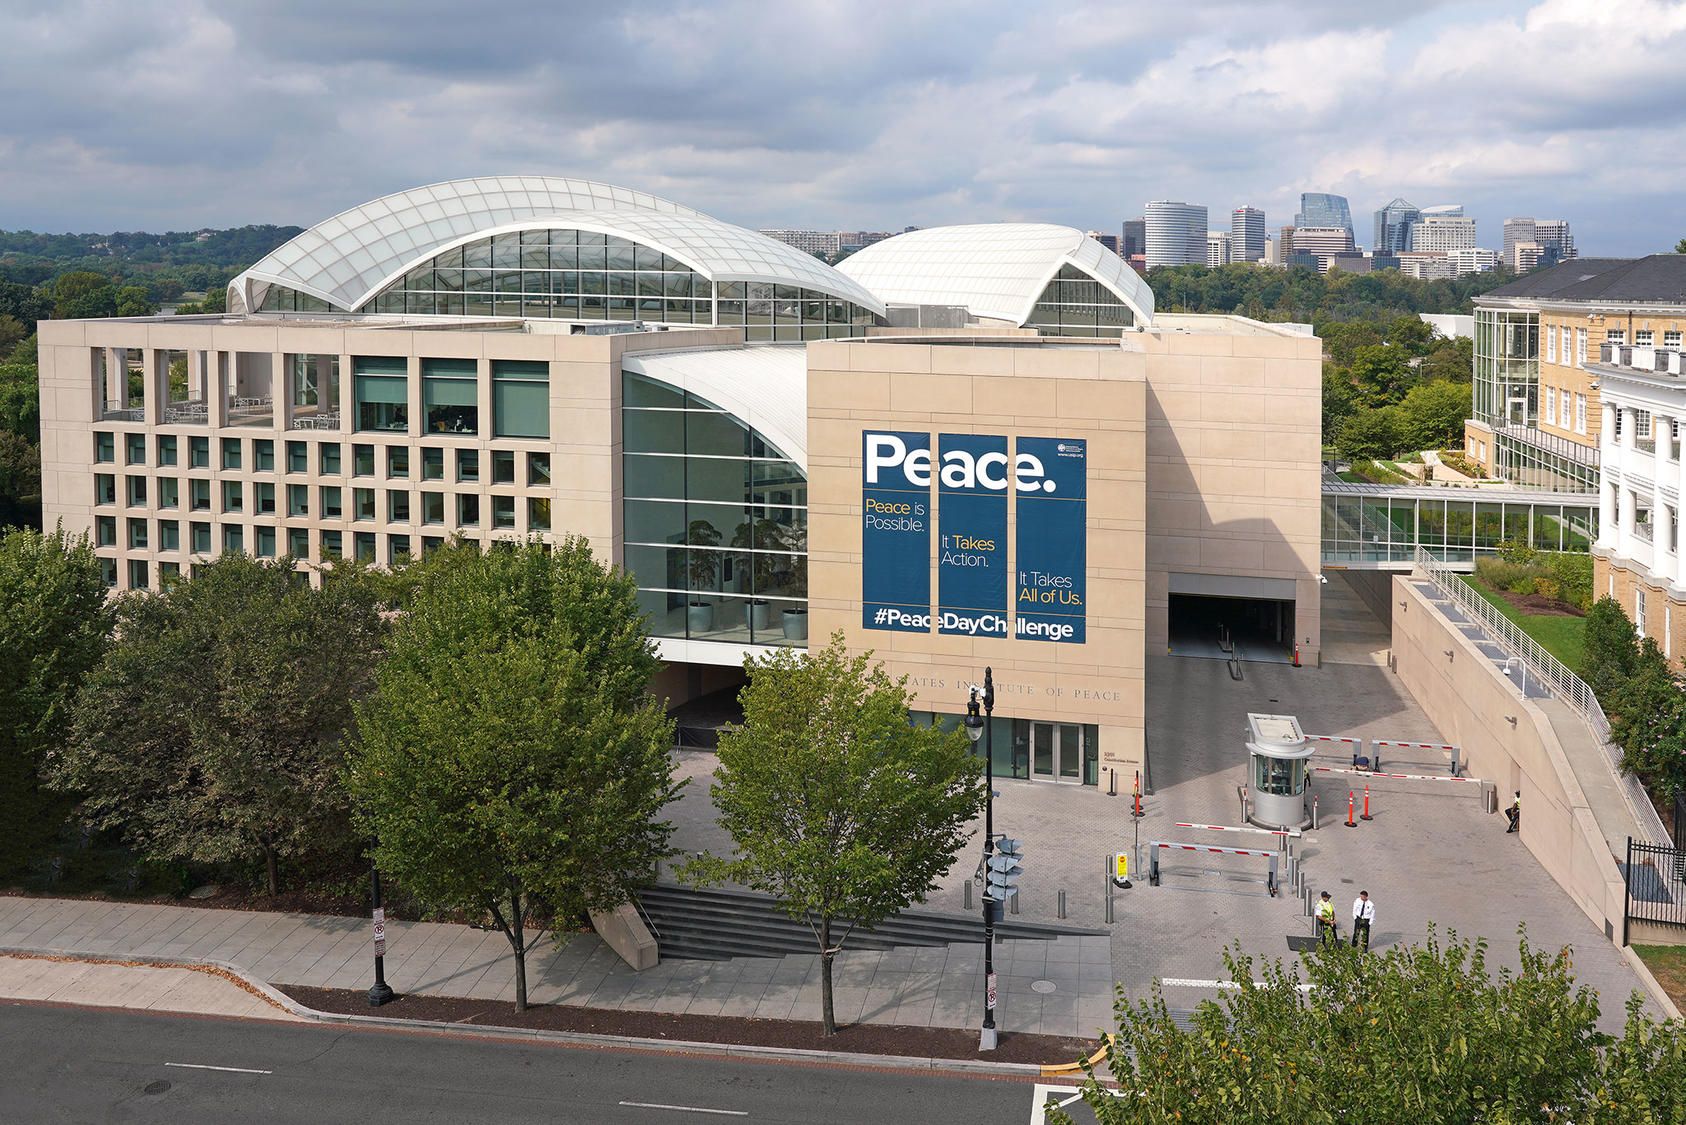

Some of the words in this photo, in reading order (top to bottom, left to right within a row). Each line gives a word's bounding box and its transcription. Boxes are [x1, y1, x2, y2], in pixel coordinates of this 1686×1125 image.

[866, 434, 1056, 493] Peace.
[866, 498, 911, 515] Peace
[914, 502, 925, 516] is
[866, 515, 924, 532] Possible.
[942, 535, 950, 549] It
[952, 535, 995, 551] Takes
[941, 551, 989, 568] Action.
[1019, 571, 1027, 586] It
[1030, 572, 1072, 588] Takes
[1019, 588, 1038, 603] All
[1041, 589, 1056, 603] of
[1059, 590, 1083, 605] Us.
[895, 676, 945, 689] SATES
[1046, 687, 1063, 697] OF
[1074, 689, 1121, 701] PEACE
